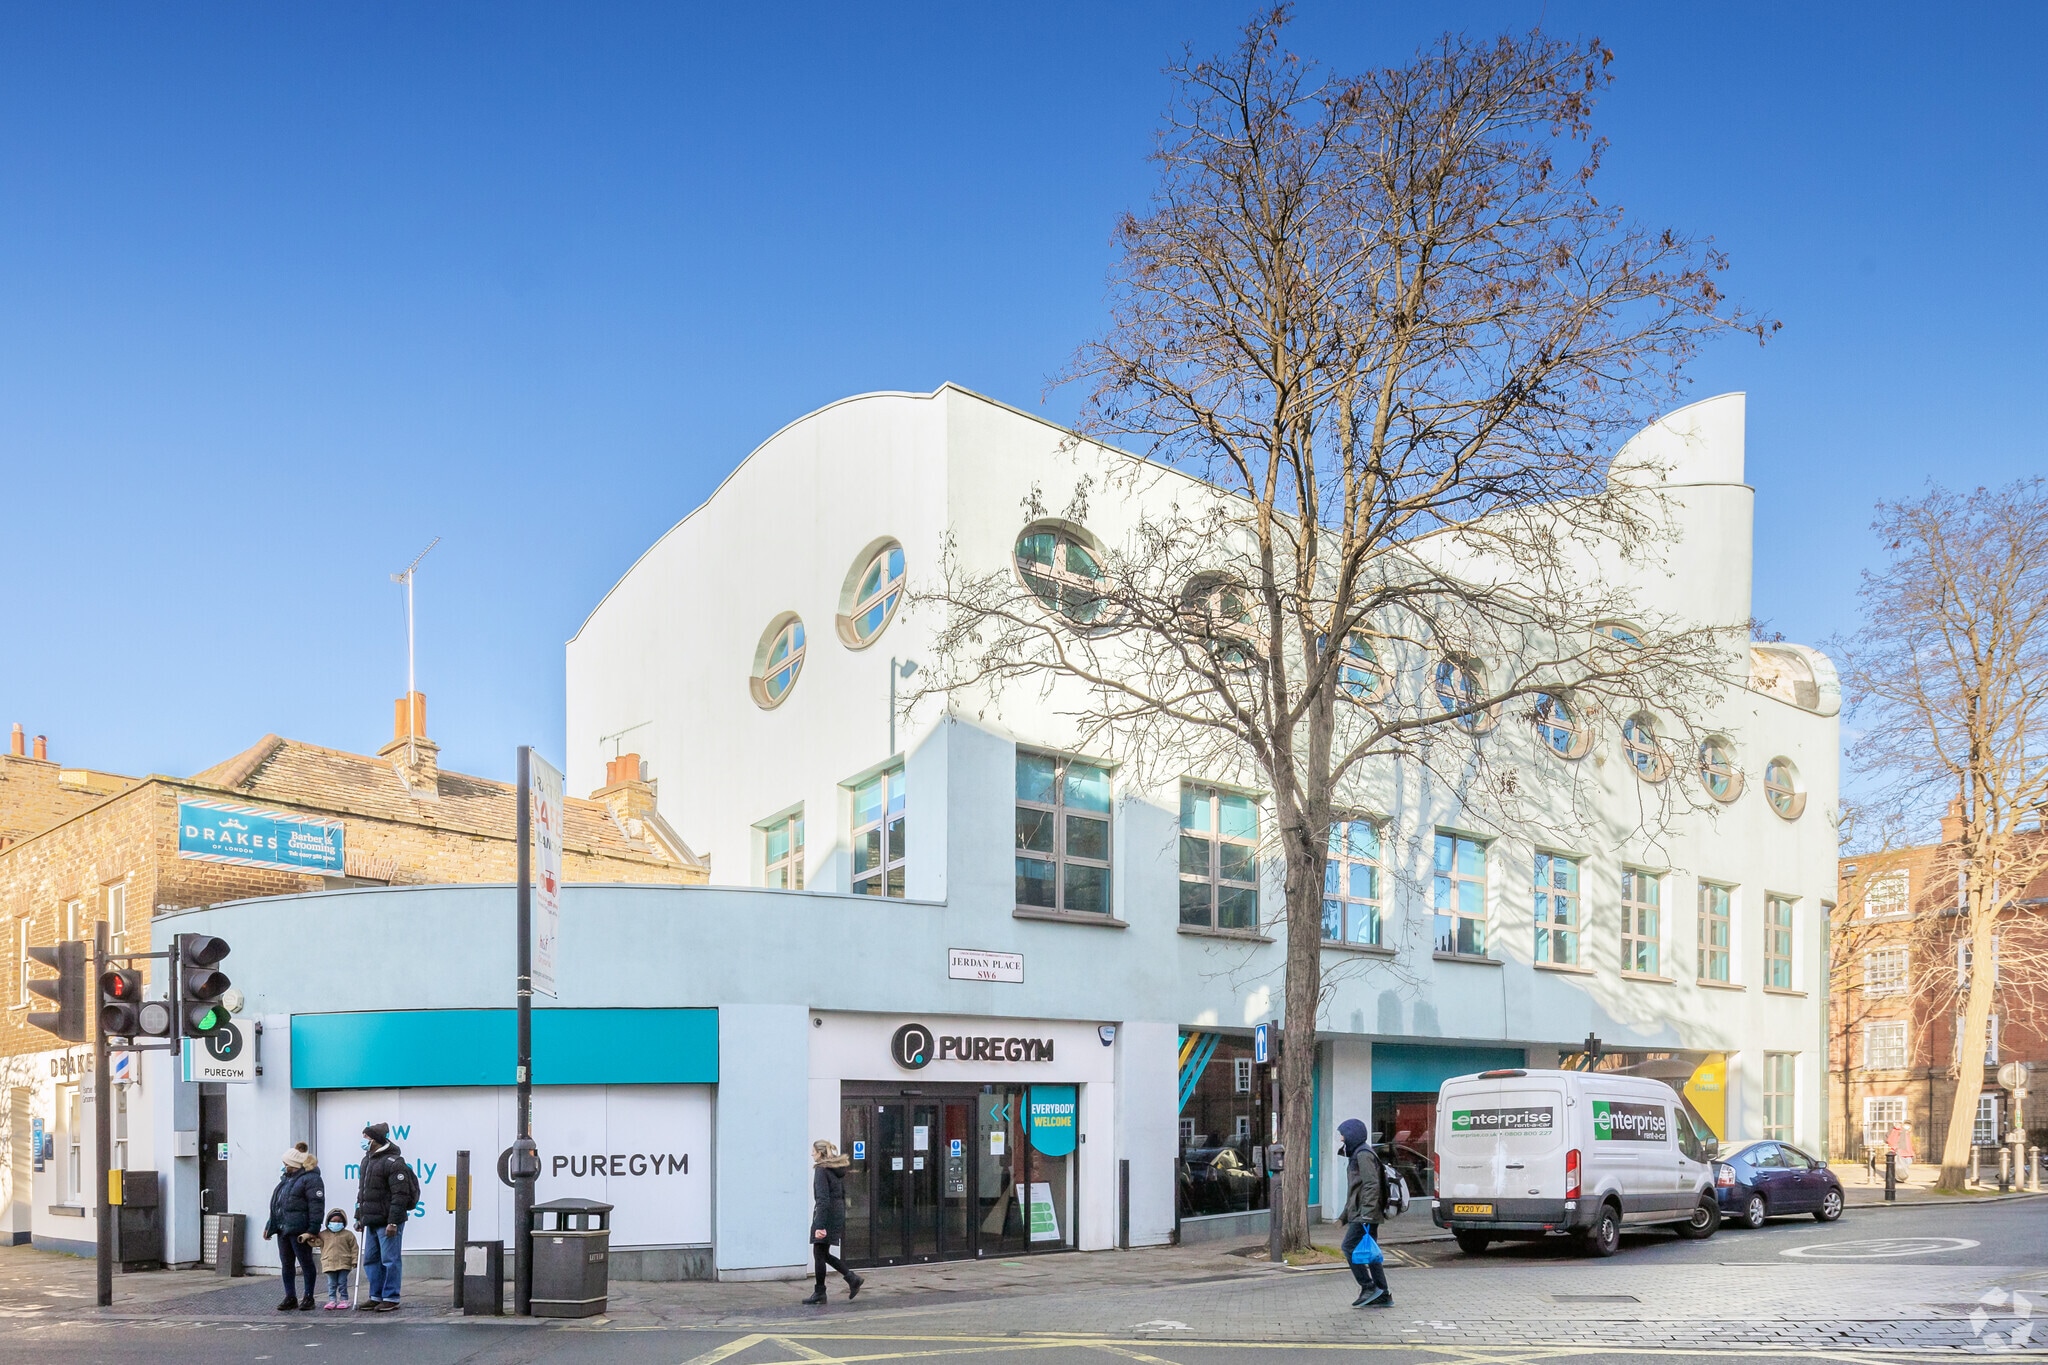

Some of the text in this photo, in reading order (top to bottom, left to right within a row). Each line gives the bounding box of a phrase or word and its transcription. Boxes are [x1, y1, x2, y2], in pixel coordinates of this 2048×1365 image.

[185, 825, 277, 850] DRAKES
[291, 831, 323, 843] Barber
[224, 846, 254, 854] LONDON
[288, 840, 336, 855] Grooming
[951, 957, 1021, 970] JERDAN PLACE
[977, 971, 997, 979] SW6
[939, 1036, 1054, 1062] PUREGYM
[204, 1068, 244, 1077] PUREGYM
[1031, 1103, 1074, 1114] EVERYBODY
[1034, 1116, 1071, 1127] WELCOME
[1452, 1110, 1552, 1127] enterprise
[1594, 1111, 1666, 1136] enterprise
[1643, 1132, 1666, 1140] rent-a-car
[552, 1153, 689, 1177] PUREGYM
